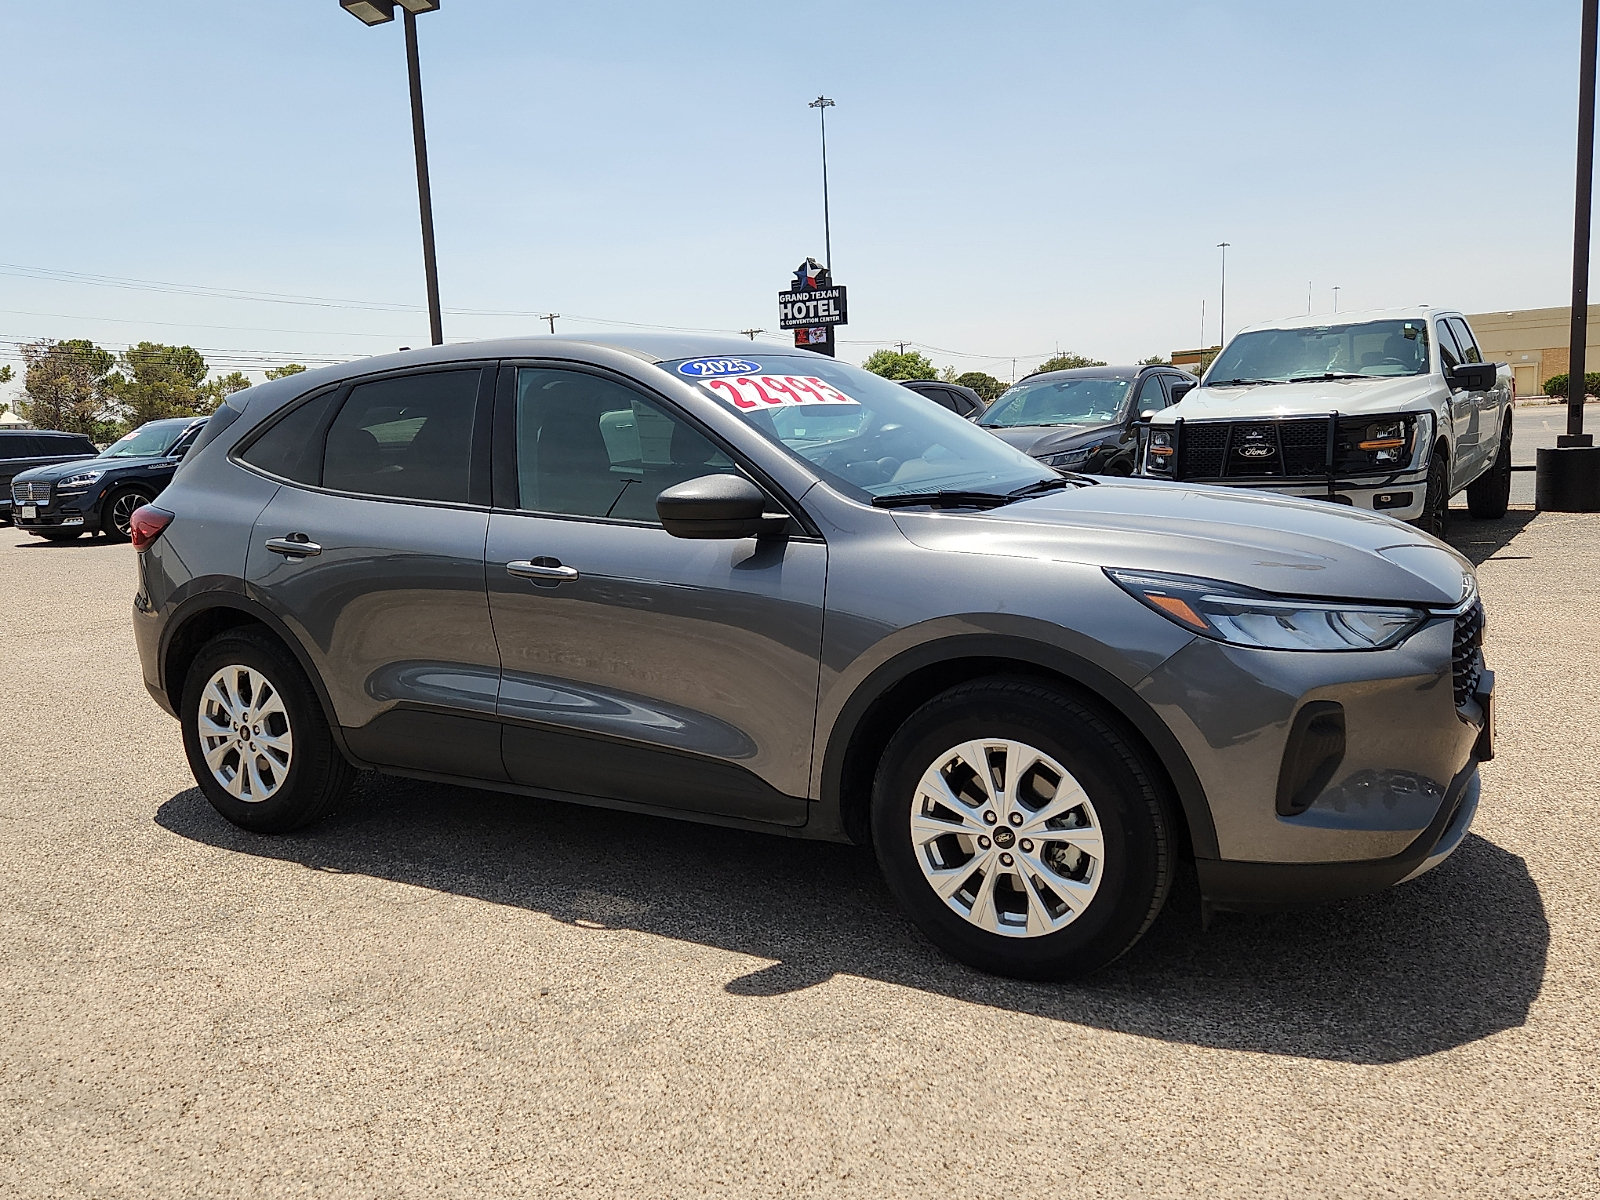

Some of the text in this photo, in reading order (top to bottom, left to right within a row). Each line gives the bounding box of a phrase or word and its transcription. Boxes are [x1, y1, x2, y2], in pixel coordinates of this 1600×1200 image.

[779, 289, 839, 302] GRAND TEXAN
[780, 299, 840, 320] HOTEL
[786, 317, 819, 326] CONVENTION
[692, 358, 750, 376] 2025
[709, 376, 848, 408] 22995
[1245, 447, 1268, 455] Ford
